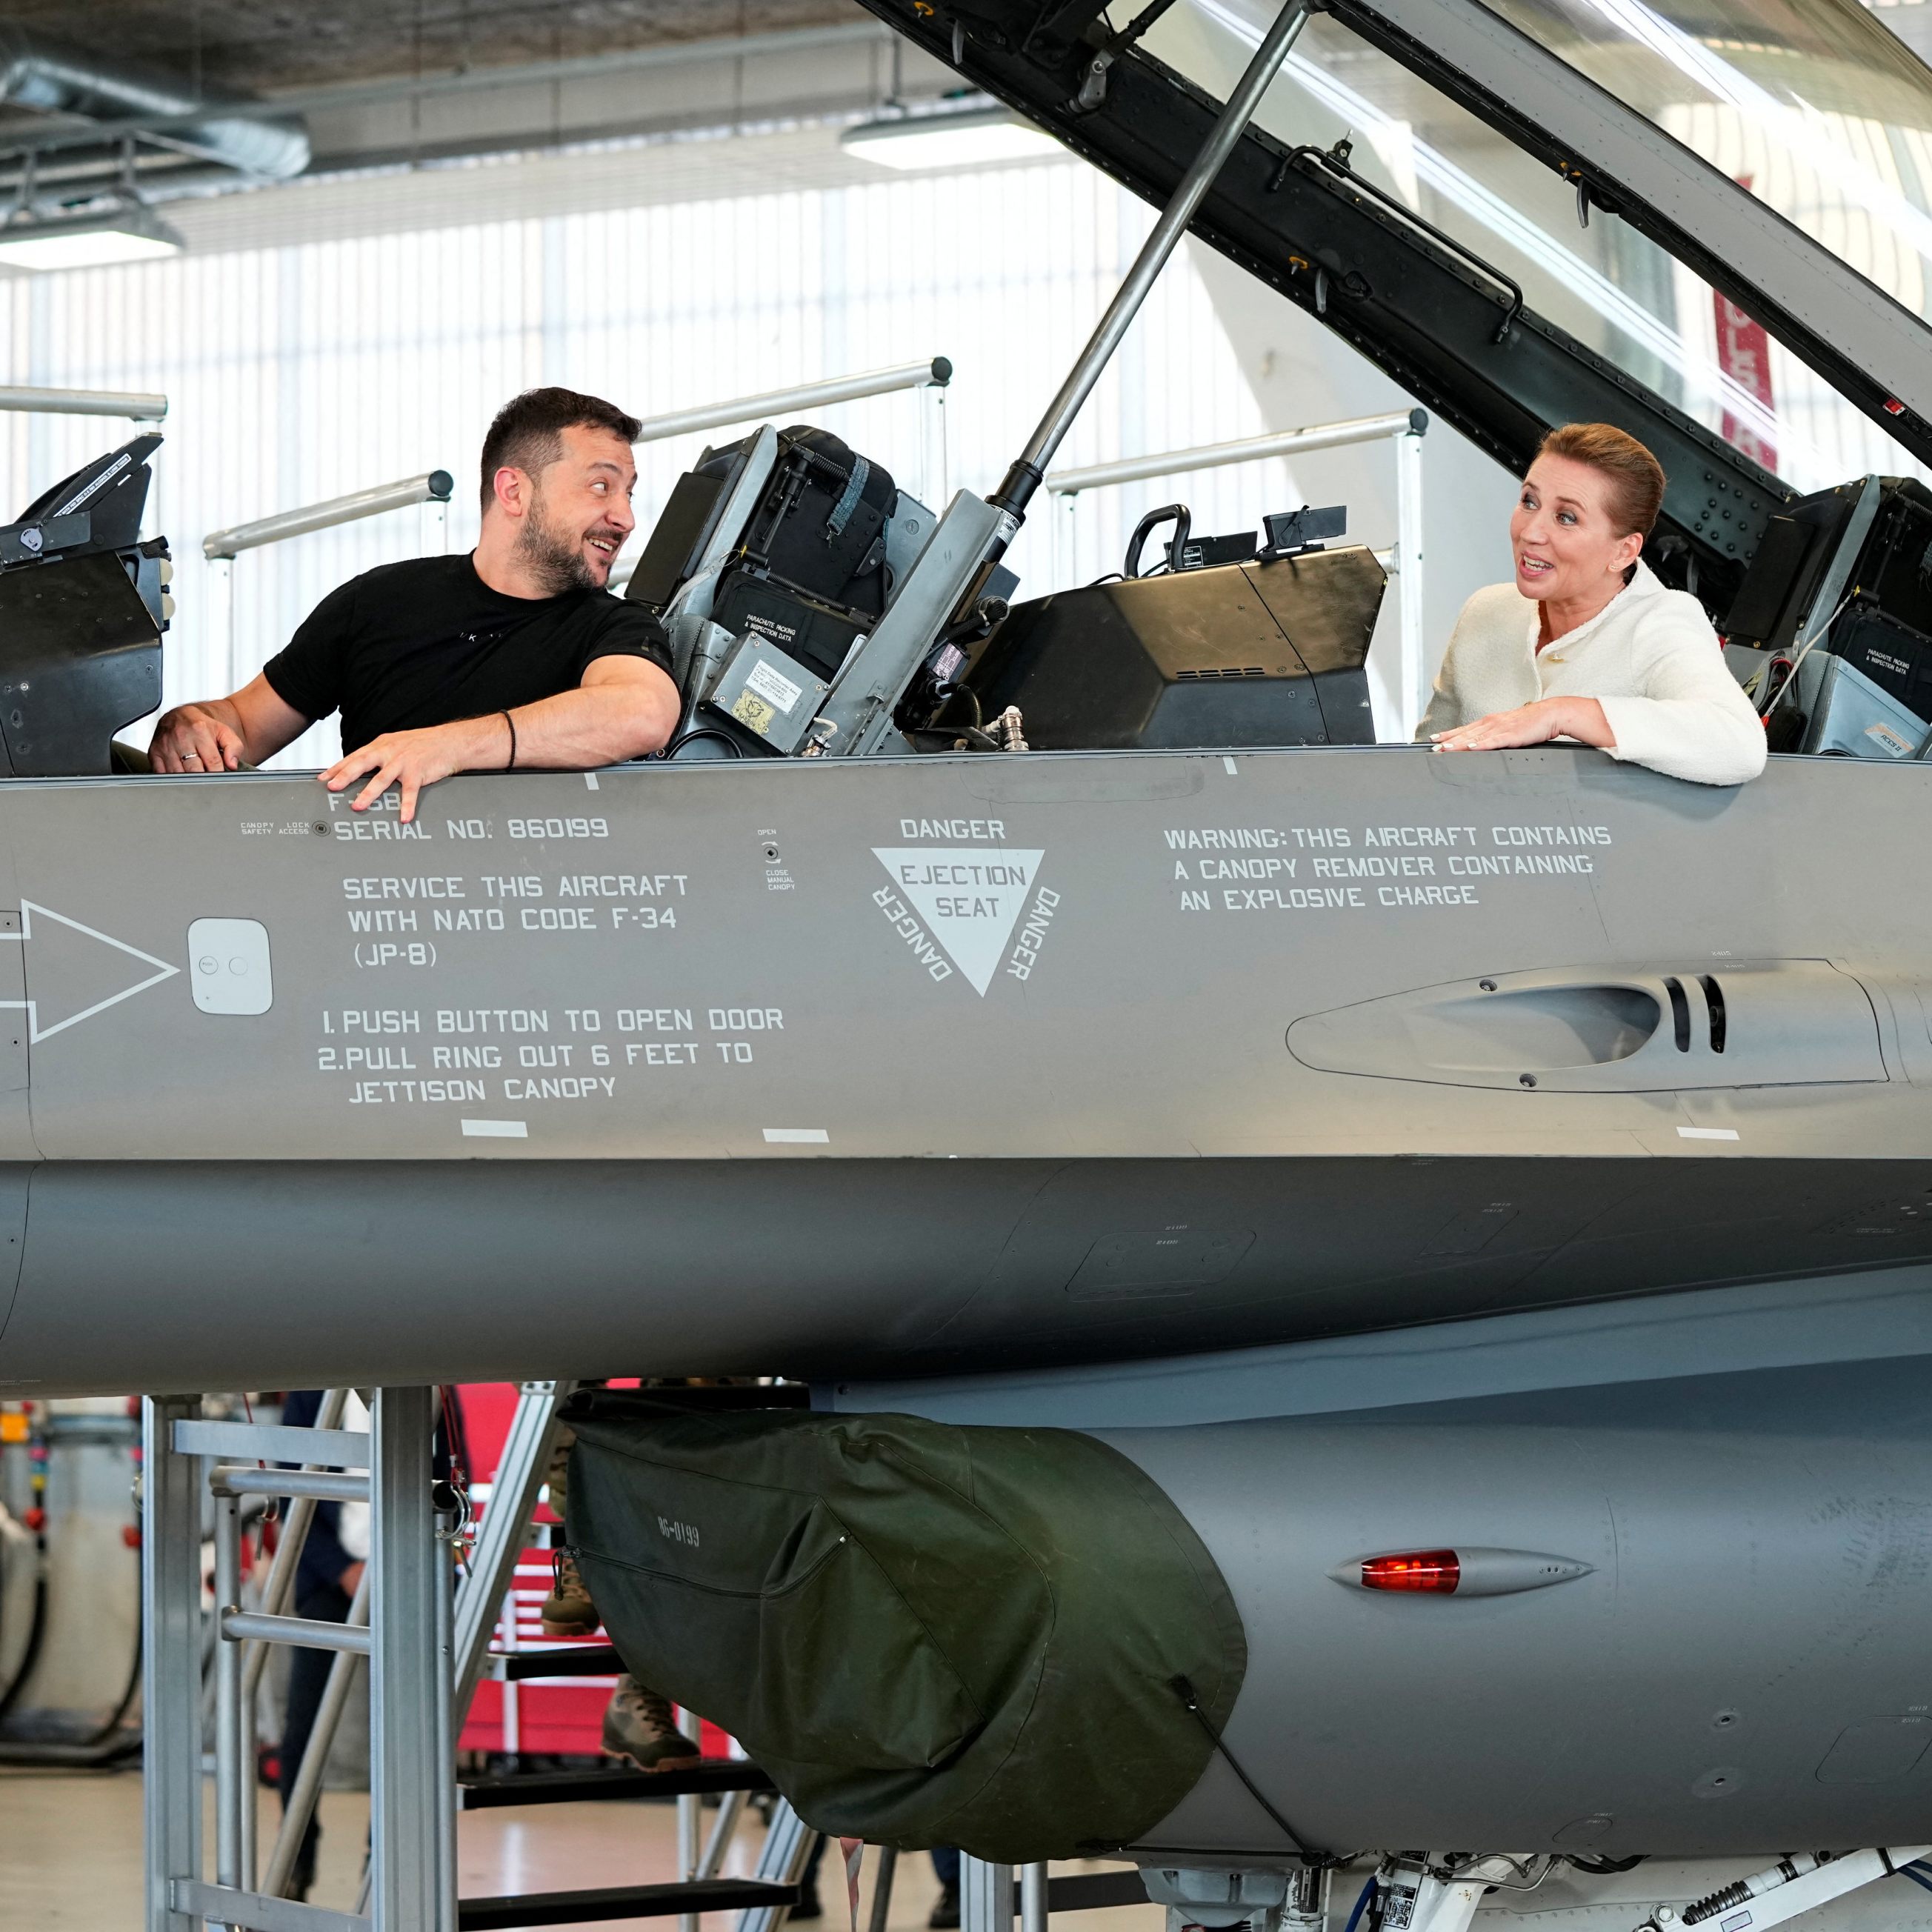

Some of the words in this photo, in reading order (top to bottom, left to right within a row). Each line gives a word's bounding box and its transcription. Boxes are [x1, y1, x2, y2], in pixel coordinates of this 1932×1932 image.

[96, 475, 107, 487] ALCOHOL
[747, 614, 775, 628] PARACHUTE
[776, 624, 796, 636] PACKING
[750, 622, 778, 637] INSPECTION
[779, 633, 791, 642] DATA
[1868, 649, 1892, 662] PARACHUTE
[1893, 658, 1910, 670] PACKING
[1871, 656, 1895, 670] INSPECTION
[1895, 666, 1906, 675] DATA
[1881, 734, 1896, 747] ACES
[334, 821, 431, 840] SERIAL
[507, 819, 608, 839] 860199
[900, 819, 1006, 839] DANGER
[1164, 829, 1287, 850] WARNING:
[1292, 828, 1350, 847] THIS
[1365, 827, 1476, 847] AIRCRAFT
[1492, 826, 1612, 845] CONTAINS
[900, 865, 1026, 885] EJECTION
[1175, 860, 1189, 879] A
[1199, 859, 1296, 879] CANOPY
[1313, 857, 1436, 877] REMOVER
[1448, 855, 1593, 875] CONTAINING
[343, 877, 465, 899] SERVICE
[482, 876, 543, 897] THIS
[559, 875, 688, 896] AIRCRAFT
[1180, 891, 1211, 910] AN
[1224, 887, 1365, 909] EXPLOSIVE
[1378, 886, 1479, 906] CHARGE
[348, 910, 417, 932] WITH
[434, 909, 505, 930] NATO
[521, 908, 597, 930] CODE
[613, 907, 676, 928] F-34
[936, 897, 999, 918] SEAT
[872, 886, 953, 982] DANGER
[1007, 886, 1061, 981] DANGER
[355, 942, 437, 967] (JP-8)
[437, 1010, 548, 1033] BUTTON
[565, 1010, 601, 1032] TO
[617, 1009, 693, 1031] OPEN
[709, 1008, 785, 1030] DOOR
[433, 1047, 502, 1069] RING
[519, 1046, 573, 1067] OUT
[591, 1045, 610, 1066] 6
[626, 1044, 698, 1065] FEET
[716, 1043, 753, 1063] TO
[349, 1080, 486, 1103] JETTISON
[504, 1077, 616, 1099] CANOPY
[658, 1516, 699, 1548] 86-0199
